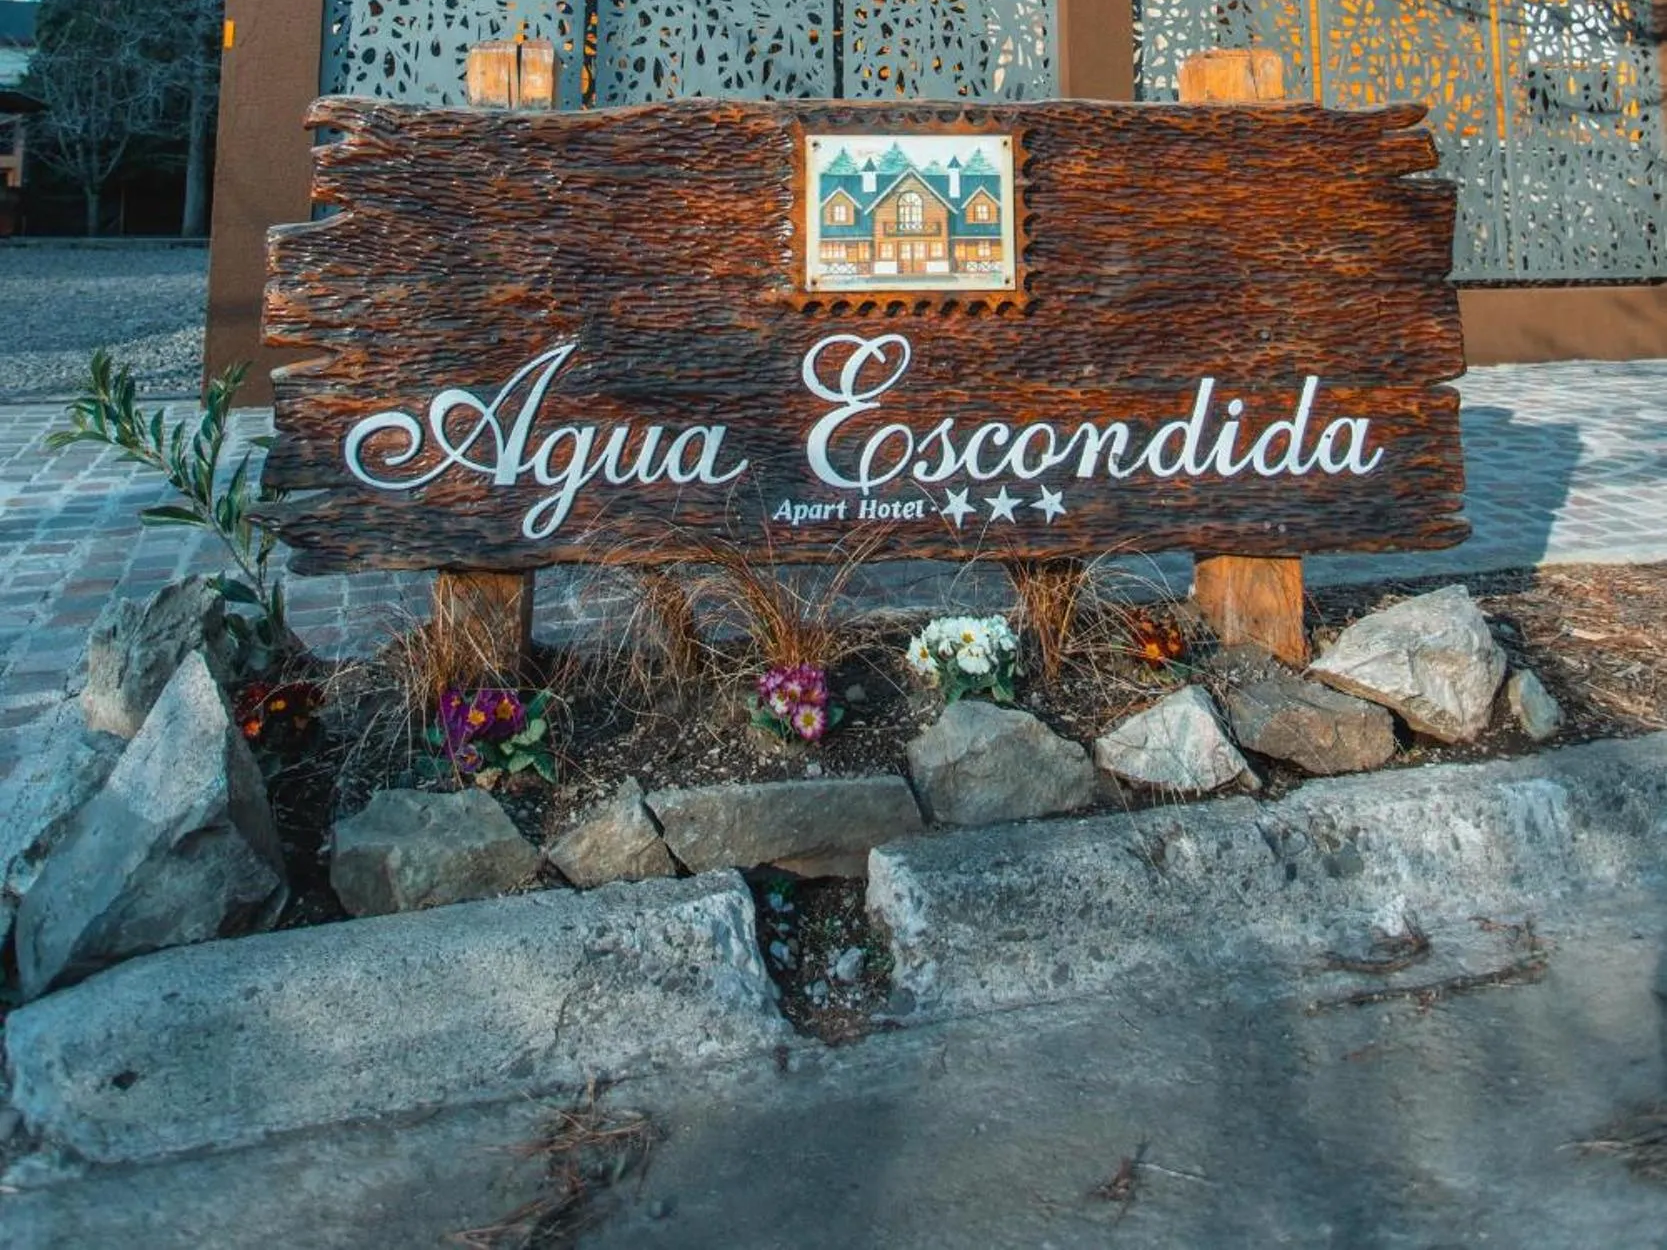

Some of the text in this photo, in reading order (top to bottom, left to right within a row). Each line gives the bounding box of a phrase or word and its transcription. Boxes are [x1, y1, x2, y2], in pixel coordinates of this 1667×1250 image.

[344, 333, 1384, 540] Agua Escondida
[772, 498, 925, 526] Apart Hotel
